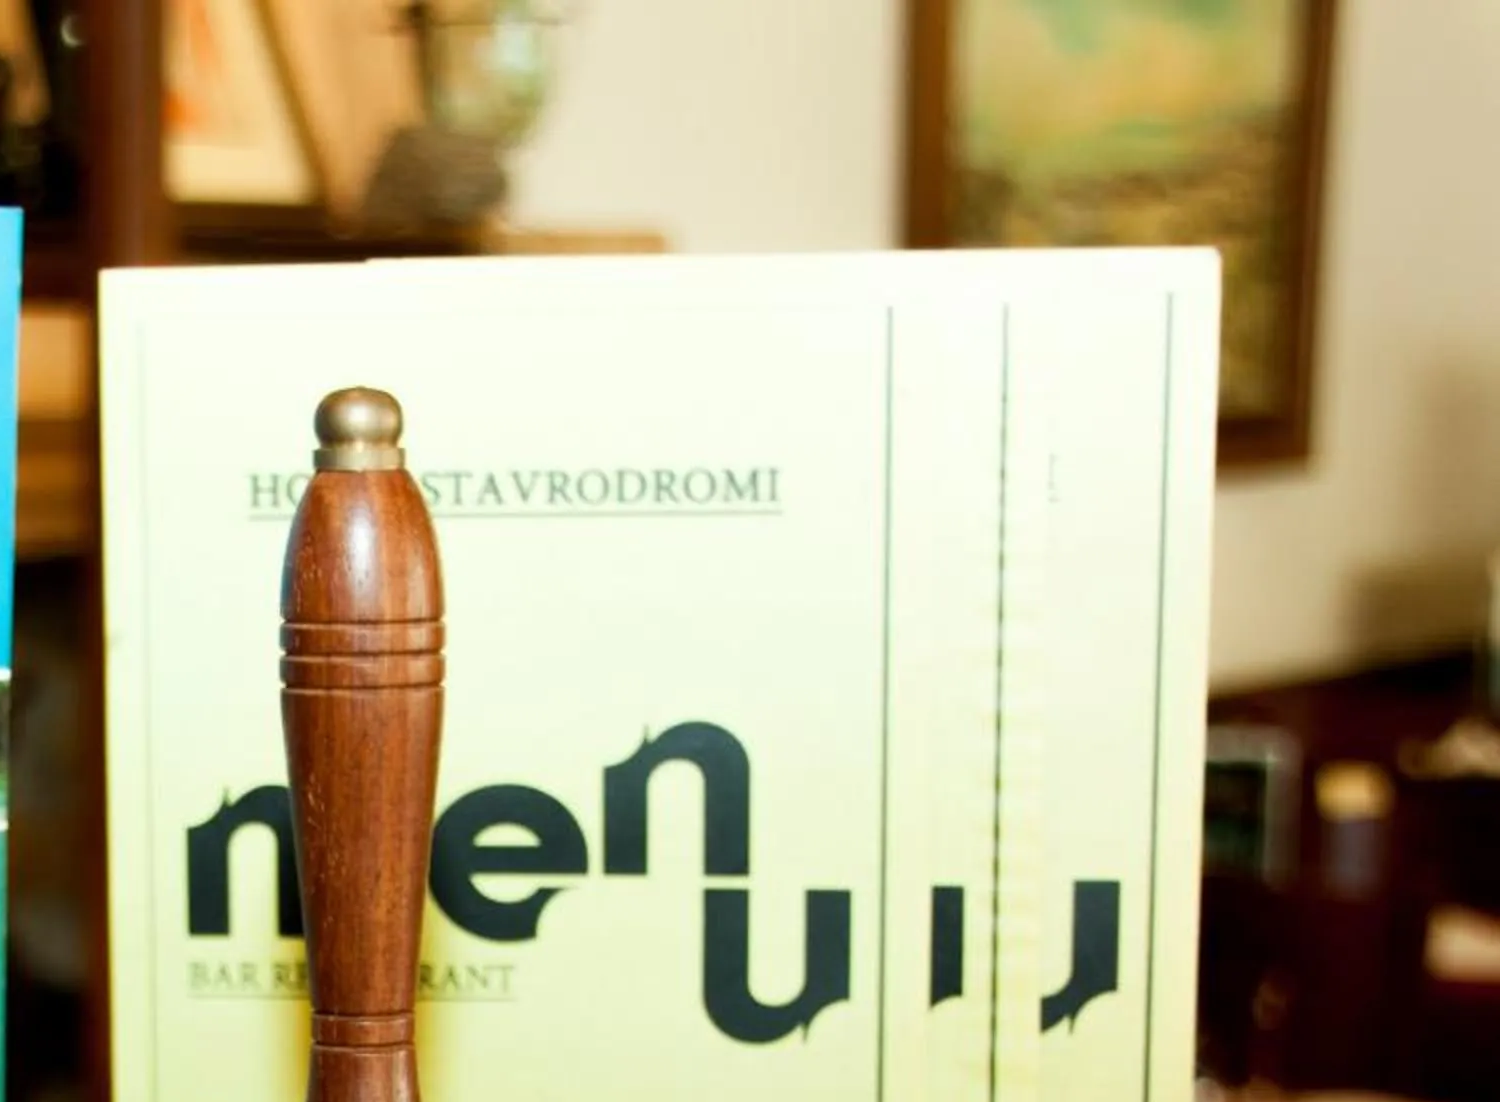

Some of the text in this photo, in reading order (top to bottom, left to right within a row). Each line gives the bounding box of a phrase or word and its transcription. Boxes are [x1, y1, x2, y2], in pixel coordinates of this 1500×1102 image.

[421, 467, 780, 507] STAVRODROMI
[188, 962, 514, 992] BAR RERANT
